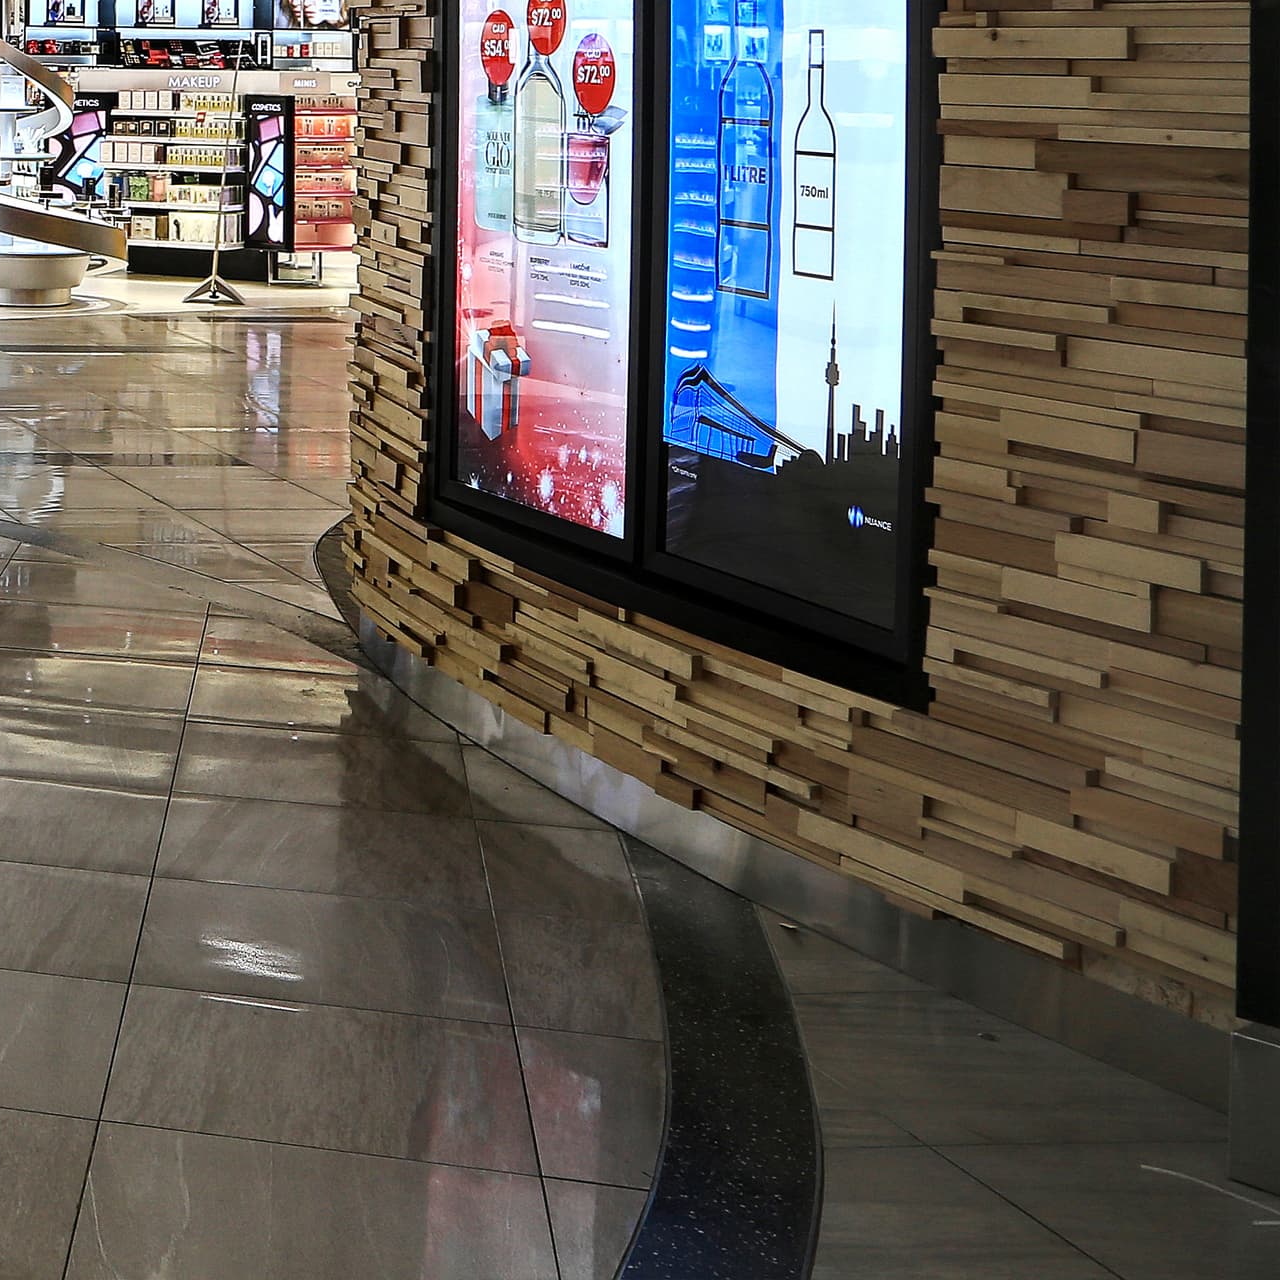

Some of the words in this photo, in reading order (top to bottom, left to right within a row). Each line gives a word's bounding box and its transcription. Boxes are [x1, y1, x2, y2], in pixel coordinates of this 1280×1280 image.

[531, 8, 562, 27] $72.00
[491, 23, 505, 34] CAD
[168, 76, 221, 88] MAKEUP
[576, 65, 611, 84] $72.00
[293, 79, 317, 88] MINIS
[730, 165, 767, 184] LITRE
[800, 185, 829, 199] 750ml
[864, 515, 893, 532] NUANCE
